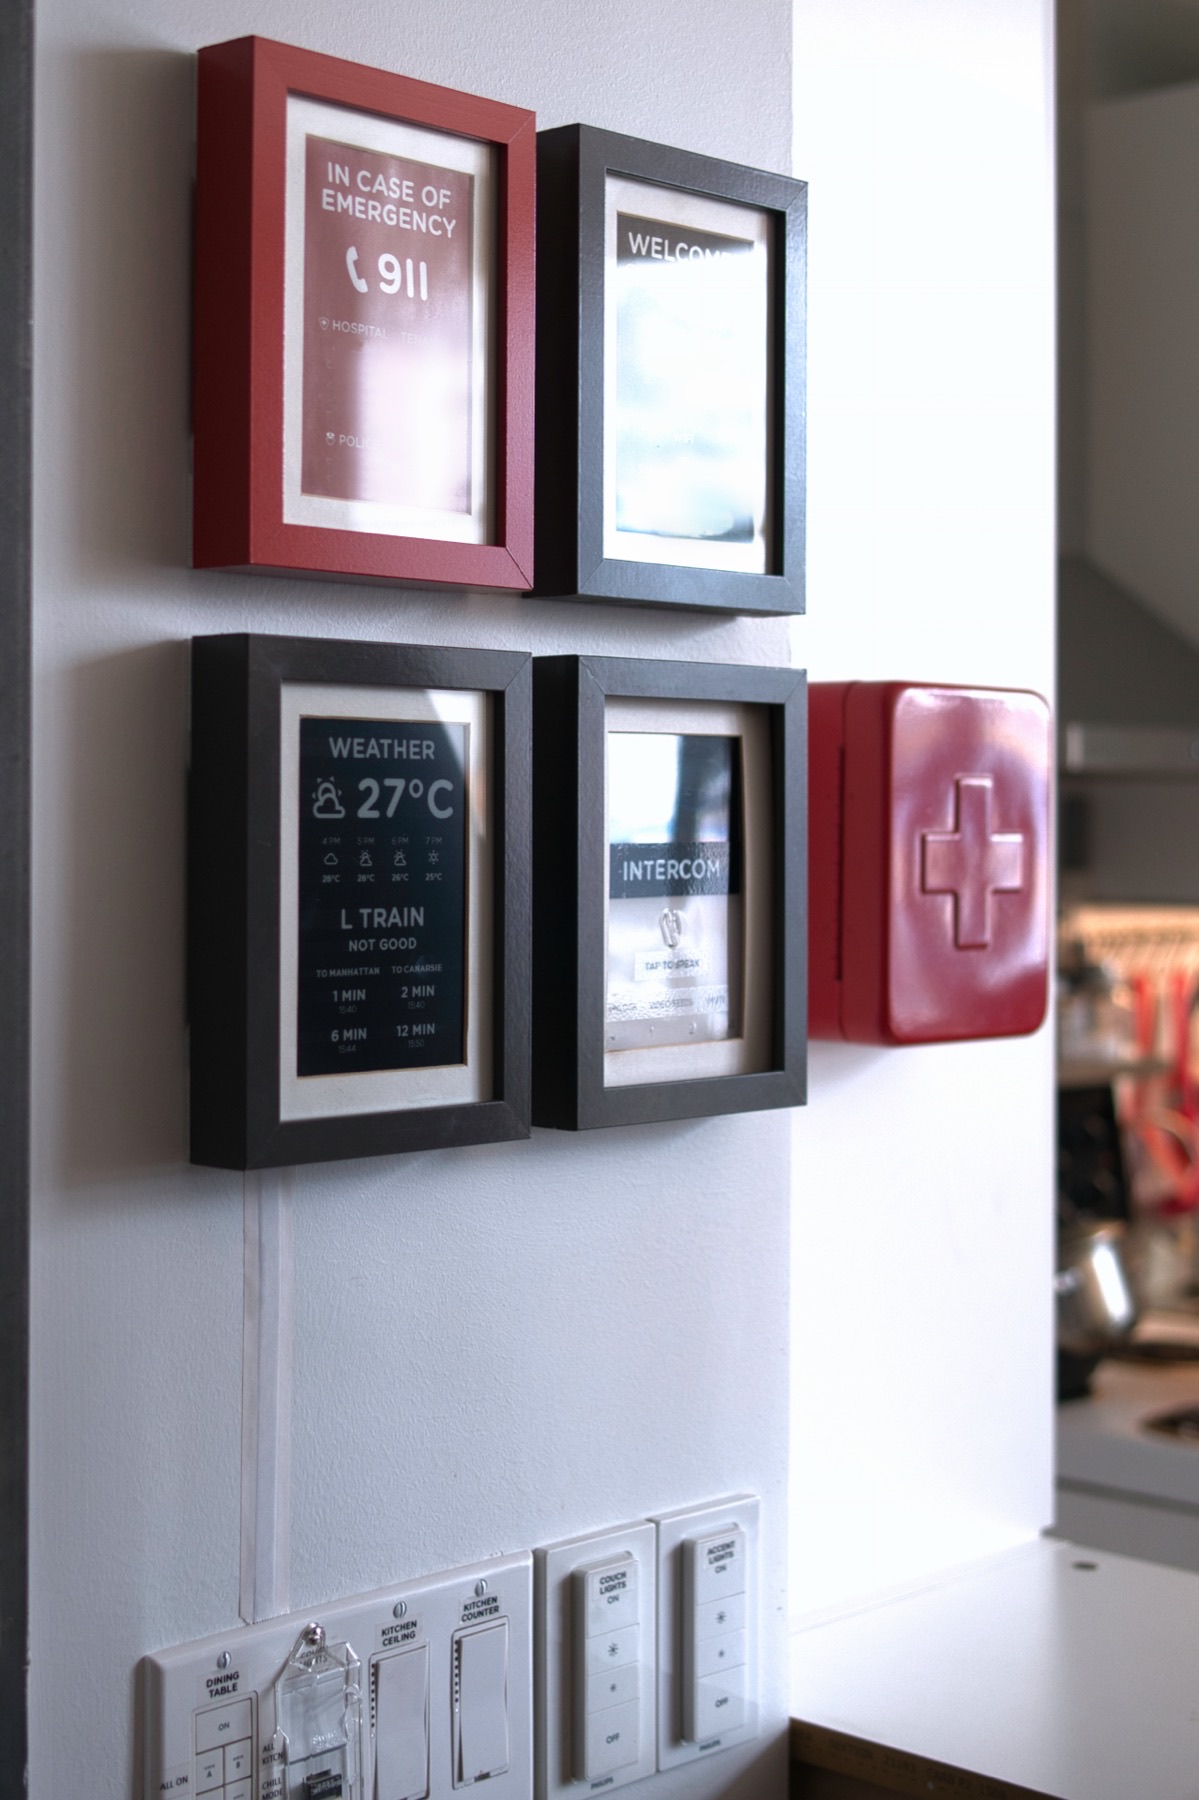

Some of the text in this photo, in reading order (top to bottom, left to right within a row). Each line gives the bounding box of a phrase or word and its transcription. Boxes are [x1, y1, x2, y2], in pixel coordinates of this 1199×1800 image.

[327, 161, 452, 210] IN CASE OF
[321, 188, 457, 239] EMERGENCY
[628, 231, 732, 262] WELCOM
[377, 252, 429, 301] 911
[332, 319, 389, 340] HOSPITAL
[339, 434, 380, 450] POLIC
[328, 736, 435, 760] WEATHER
[622, 858, 721, 882] INTERCOM
[340, 906, 425, 930] L TRAIN
[348, 937, 418, 952] NOT GOOD
[316, 966, 381, 978] TO MANHATTAN
[391, 963, 443, 974] TO CANARSIE
[645, 961, 661, 971] TAP
[662, 960, 674, 970] TO
[332, 988, 367, 1002] 1 MIN
[400, 984, 435, 999] 2 MIN
[330, 1027, 367, 1042] 6 MIN
[396, 1023, 435, 1037] 12 MIN
[708, 1550, 734, 1565] LIGHTS
[714, 1563, 727, 1574] ON
[599, 1570, 627, 1585] COUCH
[599, 1580, 627, 1595] LIGHTS
[463, 1596, 498, 1612] KITCHEN
[607, 1594, 620, 1604] ON
[461, 1605, 500, 1623] COUNTER
[381, 1620, 418, 1637] KITCHEN
[382, 1630, 416, 1647] CEILING
[206, 1671, 240, 1689] DINING
[208, 1682, 239, 1699] TABLE
[714, 1696, 729, 1708] OFF
[218, 1720, 231, 1732] ON
[606, 1732, 620, 1744] OFF
[262, 1743, 275, 1753] ALL
[206, 1770, 213, 1778] A
[159, 1774, 189, 1791] ALL ON
[262, 1777, 281, 1790] CHILL
